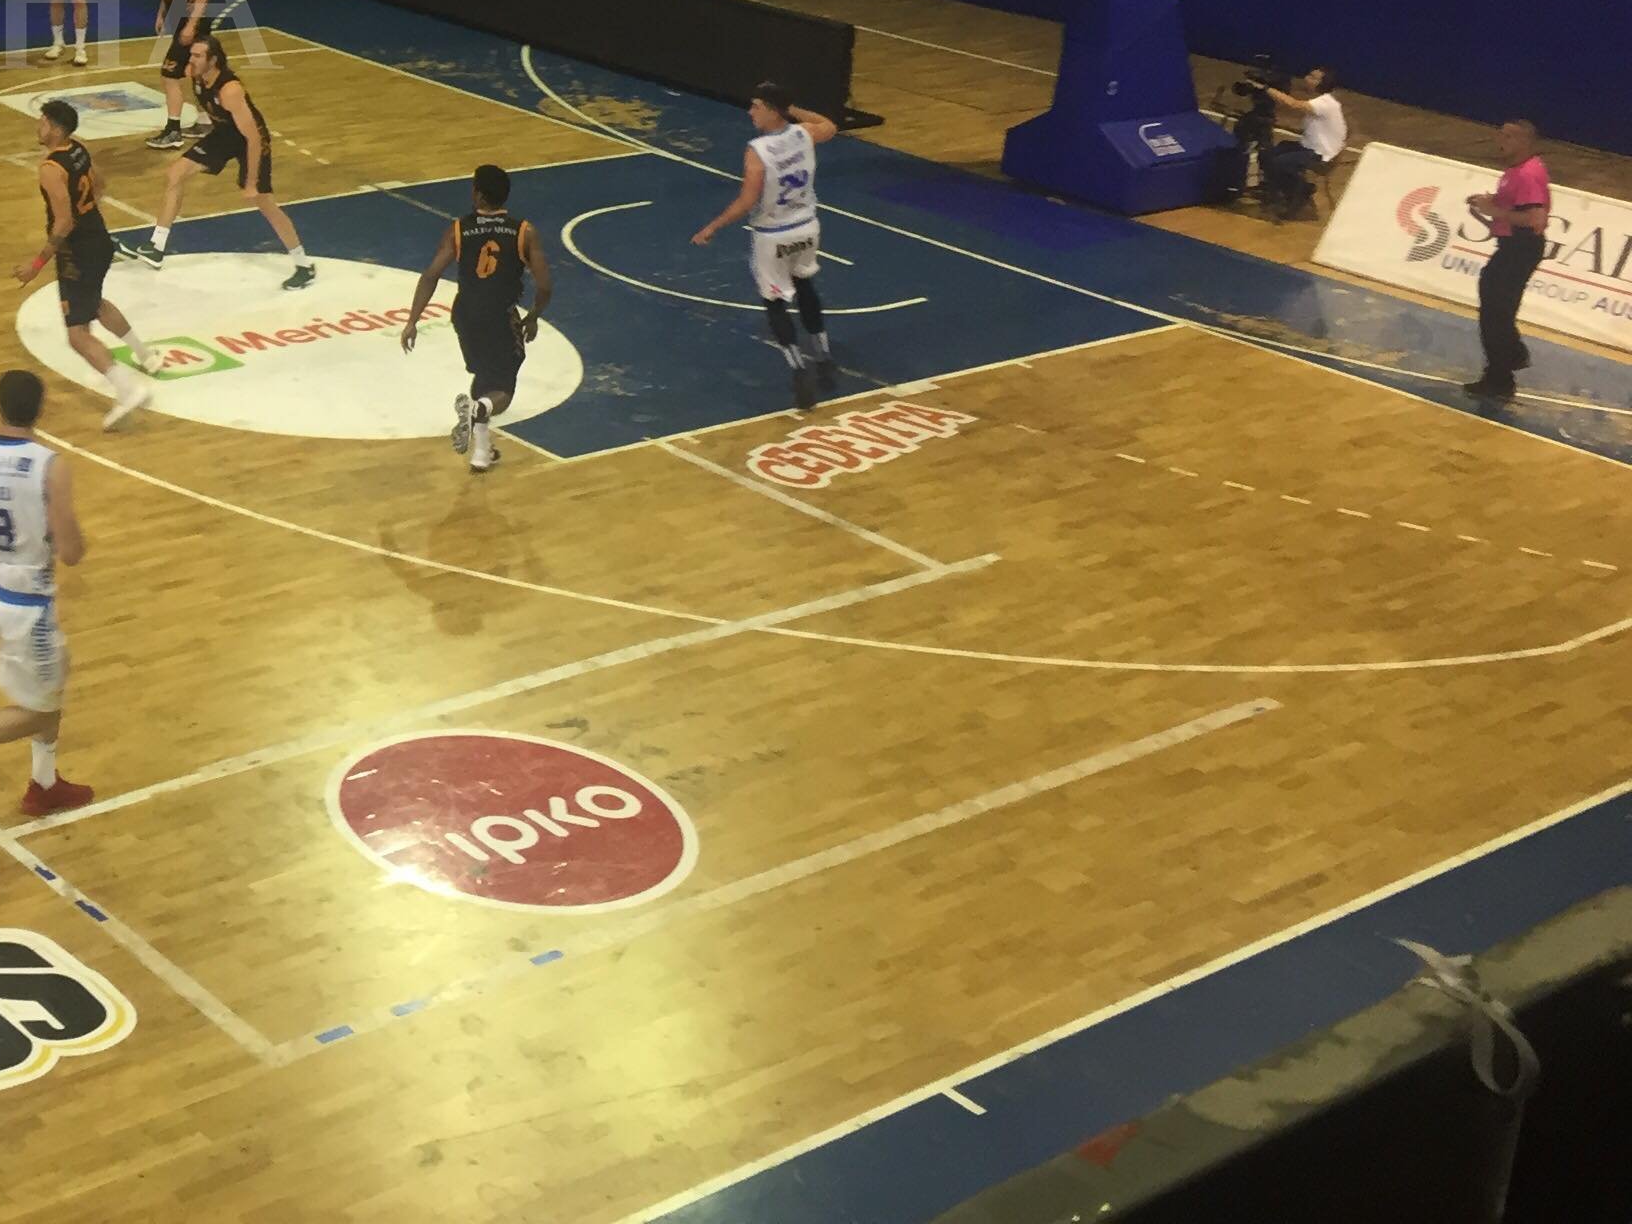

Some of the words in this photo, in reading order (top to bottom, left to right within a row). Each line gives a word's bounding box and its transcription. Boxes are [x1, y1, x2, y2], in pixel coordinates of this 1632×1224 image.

[476, 240, 500, 278] 6
[1525, 278, 1588, 304] ROUP
[757, 404, 964, 486] CEDEVITA
